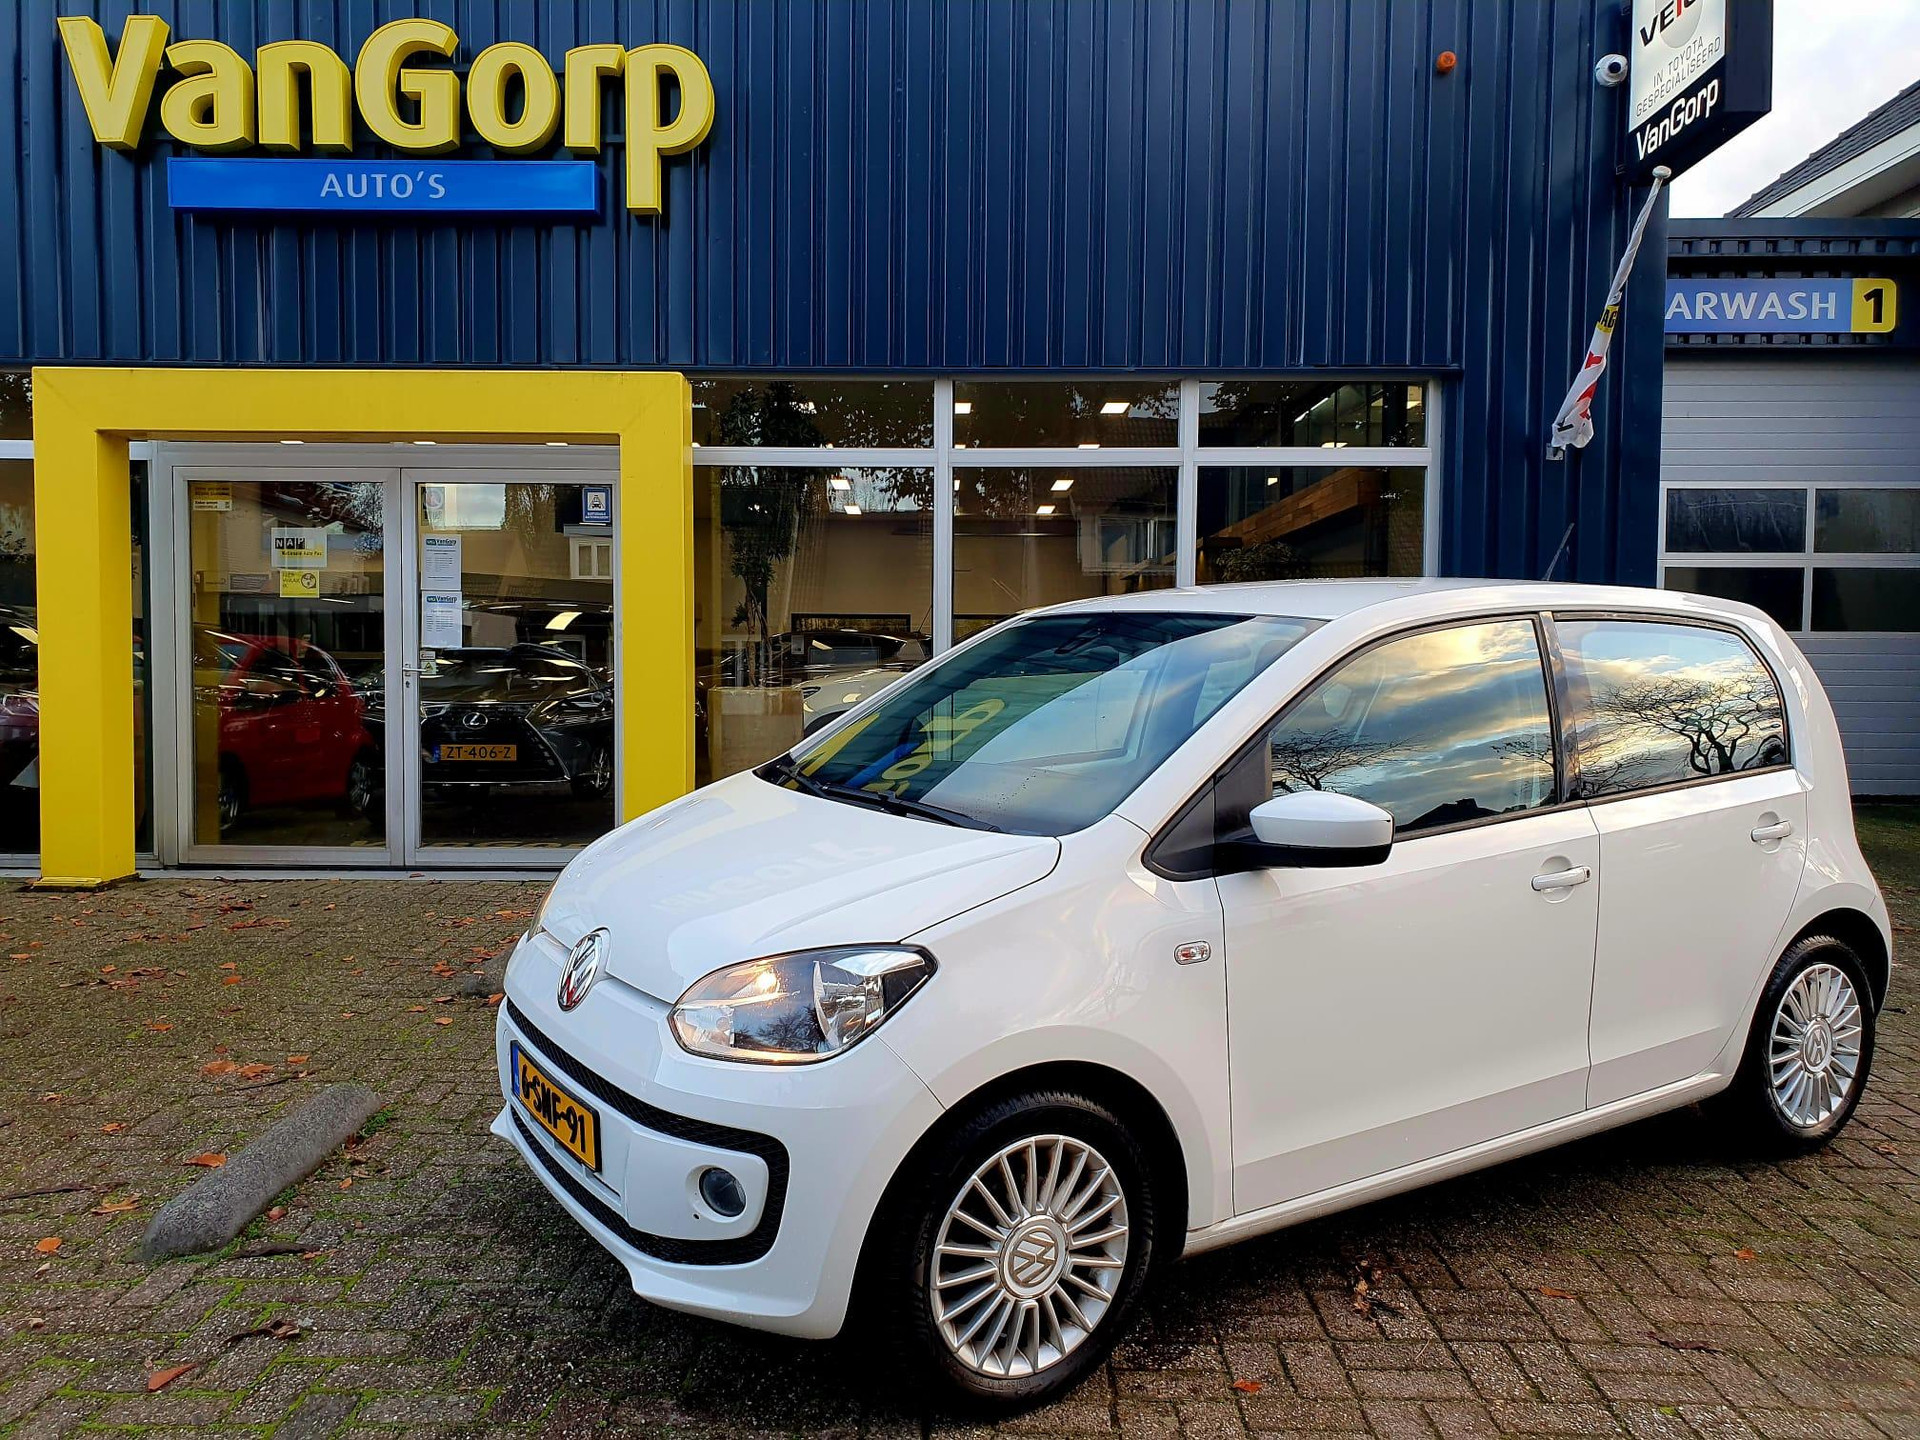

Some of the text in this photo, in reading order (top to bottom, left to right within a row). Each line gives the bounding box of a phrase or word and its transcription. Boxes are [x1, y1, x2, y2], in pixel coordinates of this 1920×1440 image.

[1635, 36, 1721, 118] GESPECIALISEERD
[1652, 36, 1704, 89] IN TOYOTA
[57, 14, 717, 216] VanGorp
[1636, 78, 1719, 161] VanGorp
[320, 172, 446, 200] AUTO'S
[1862, 288, 1884, 324] 1
[275, 537, 305, 549] NAP
[446, 746, 511, 759] ZT-406-Z
